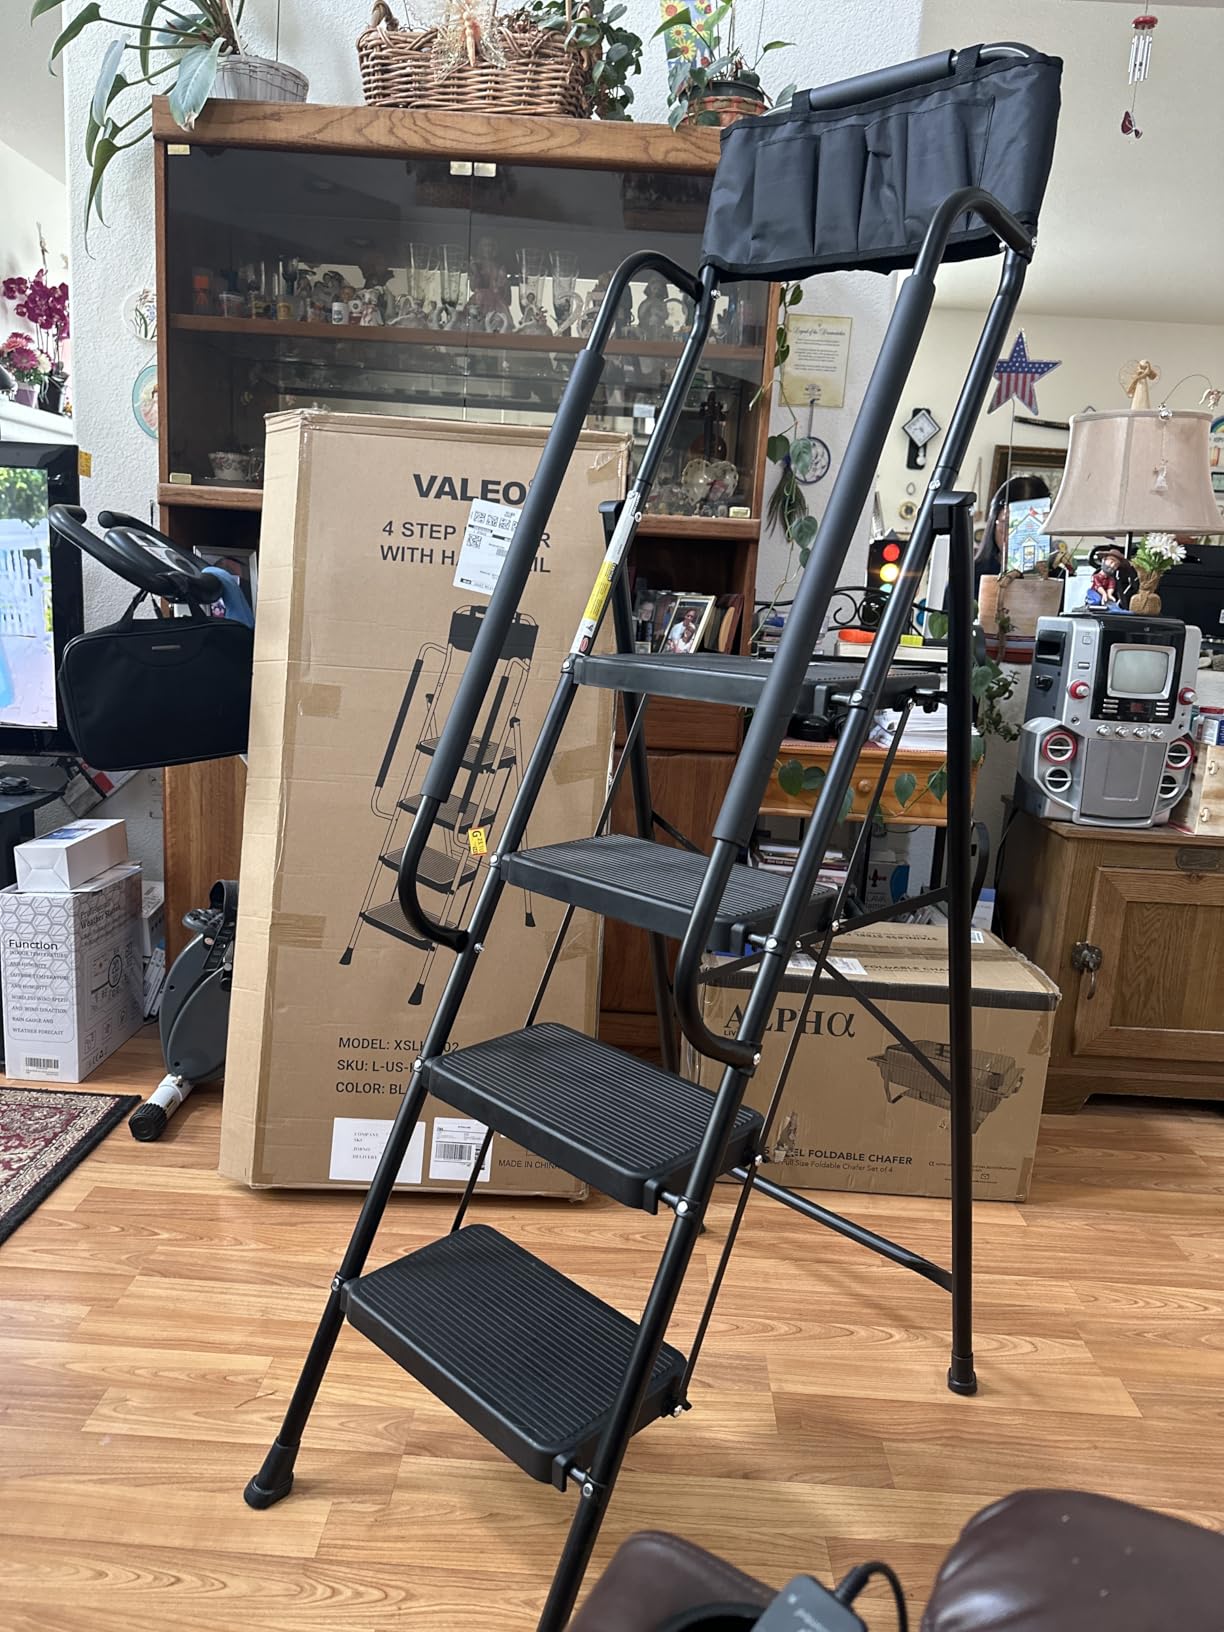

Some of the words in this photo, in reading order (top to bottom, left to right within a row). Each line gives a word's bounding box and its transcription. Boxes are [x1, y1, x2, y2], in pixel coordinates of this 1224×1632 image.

[413, 473, 528, 506] VALEO
[382, 520, 394, 536] 4
[402, 521, 456, 541] STEP
[380, 544, 434, 564] WITH
[9, 939, 58, 951] Function
[338, 1036, 391, 1050] MODEL:
[336, 1059, 368, 1072] SKU:
[335, 1081, 385, 1094] COLOR:
[498, 1159, 522, 1168] MADE
[524, 1160, 533, 1168] IN
[808, 1149, 865, 1161] FOLDABLE
[868, 1153, 913, 1165] CHAFER
[810, 1160, 841, 1169] Foldable
